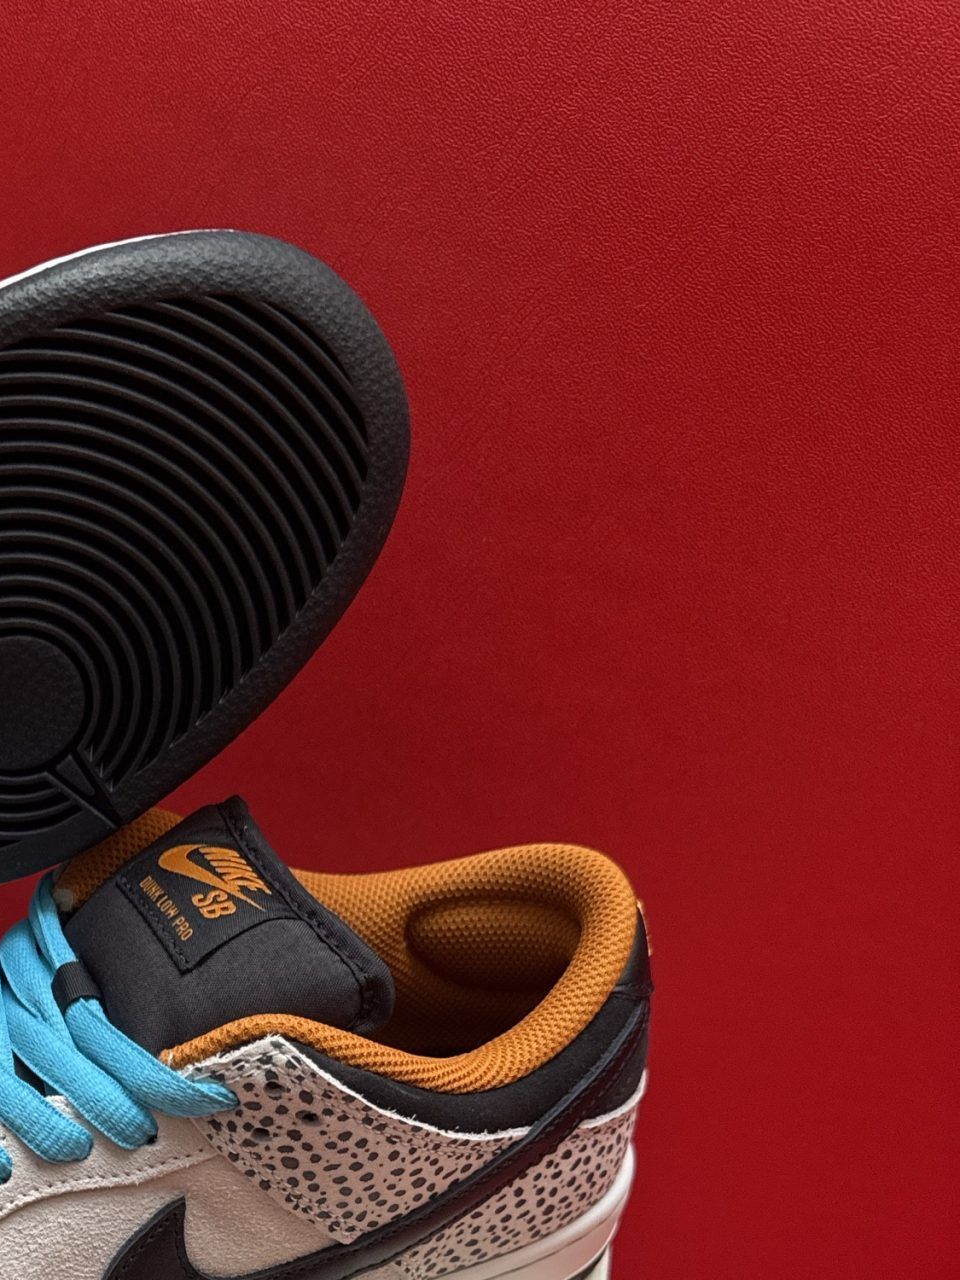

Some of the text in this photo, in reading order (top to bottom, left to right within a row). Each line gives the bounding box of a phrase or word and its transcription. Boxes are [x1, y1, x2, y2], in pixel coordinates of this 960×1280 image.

[139, 876, 194, 941] DUNK LOW PRO
[191, 890, 237, 919] SB
